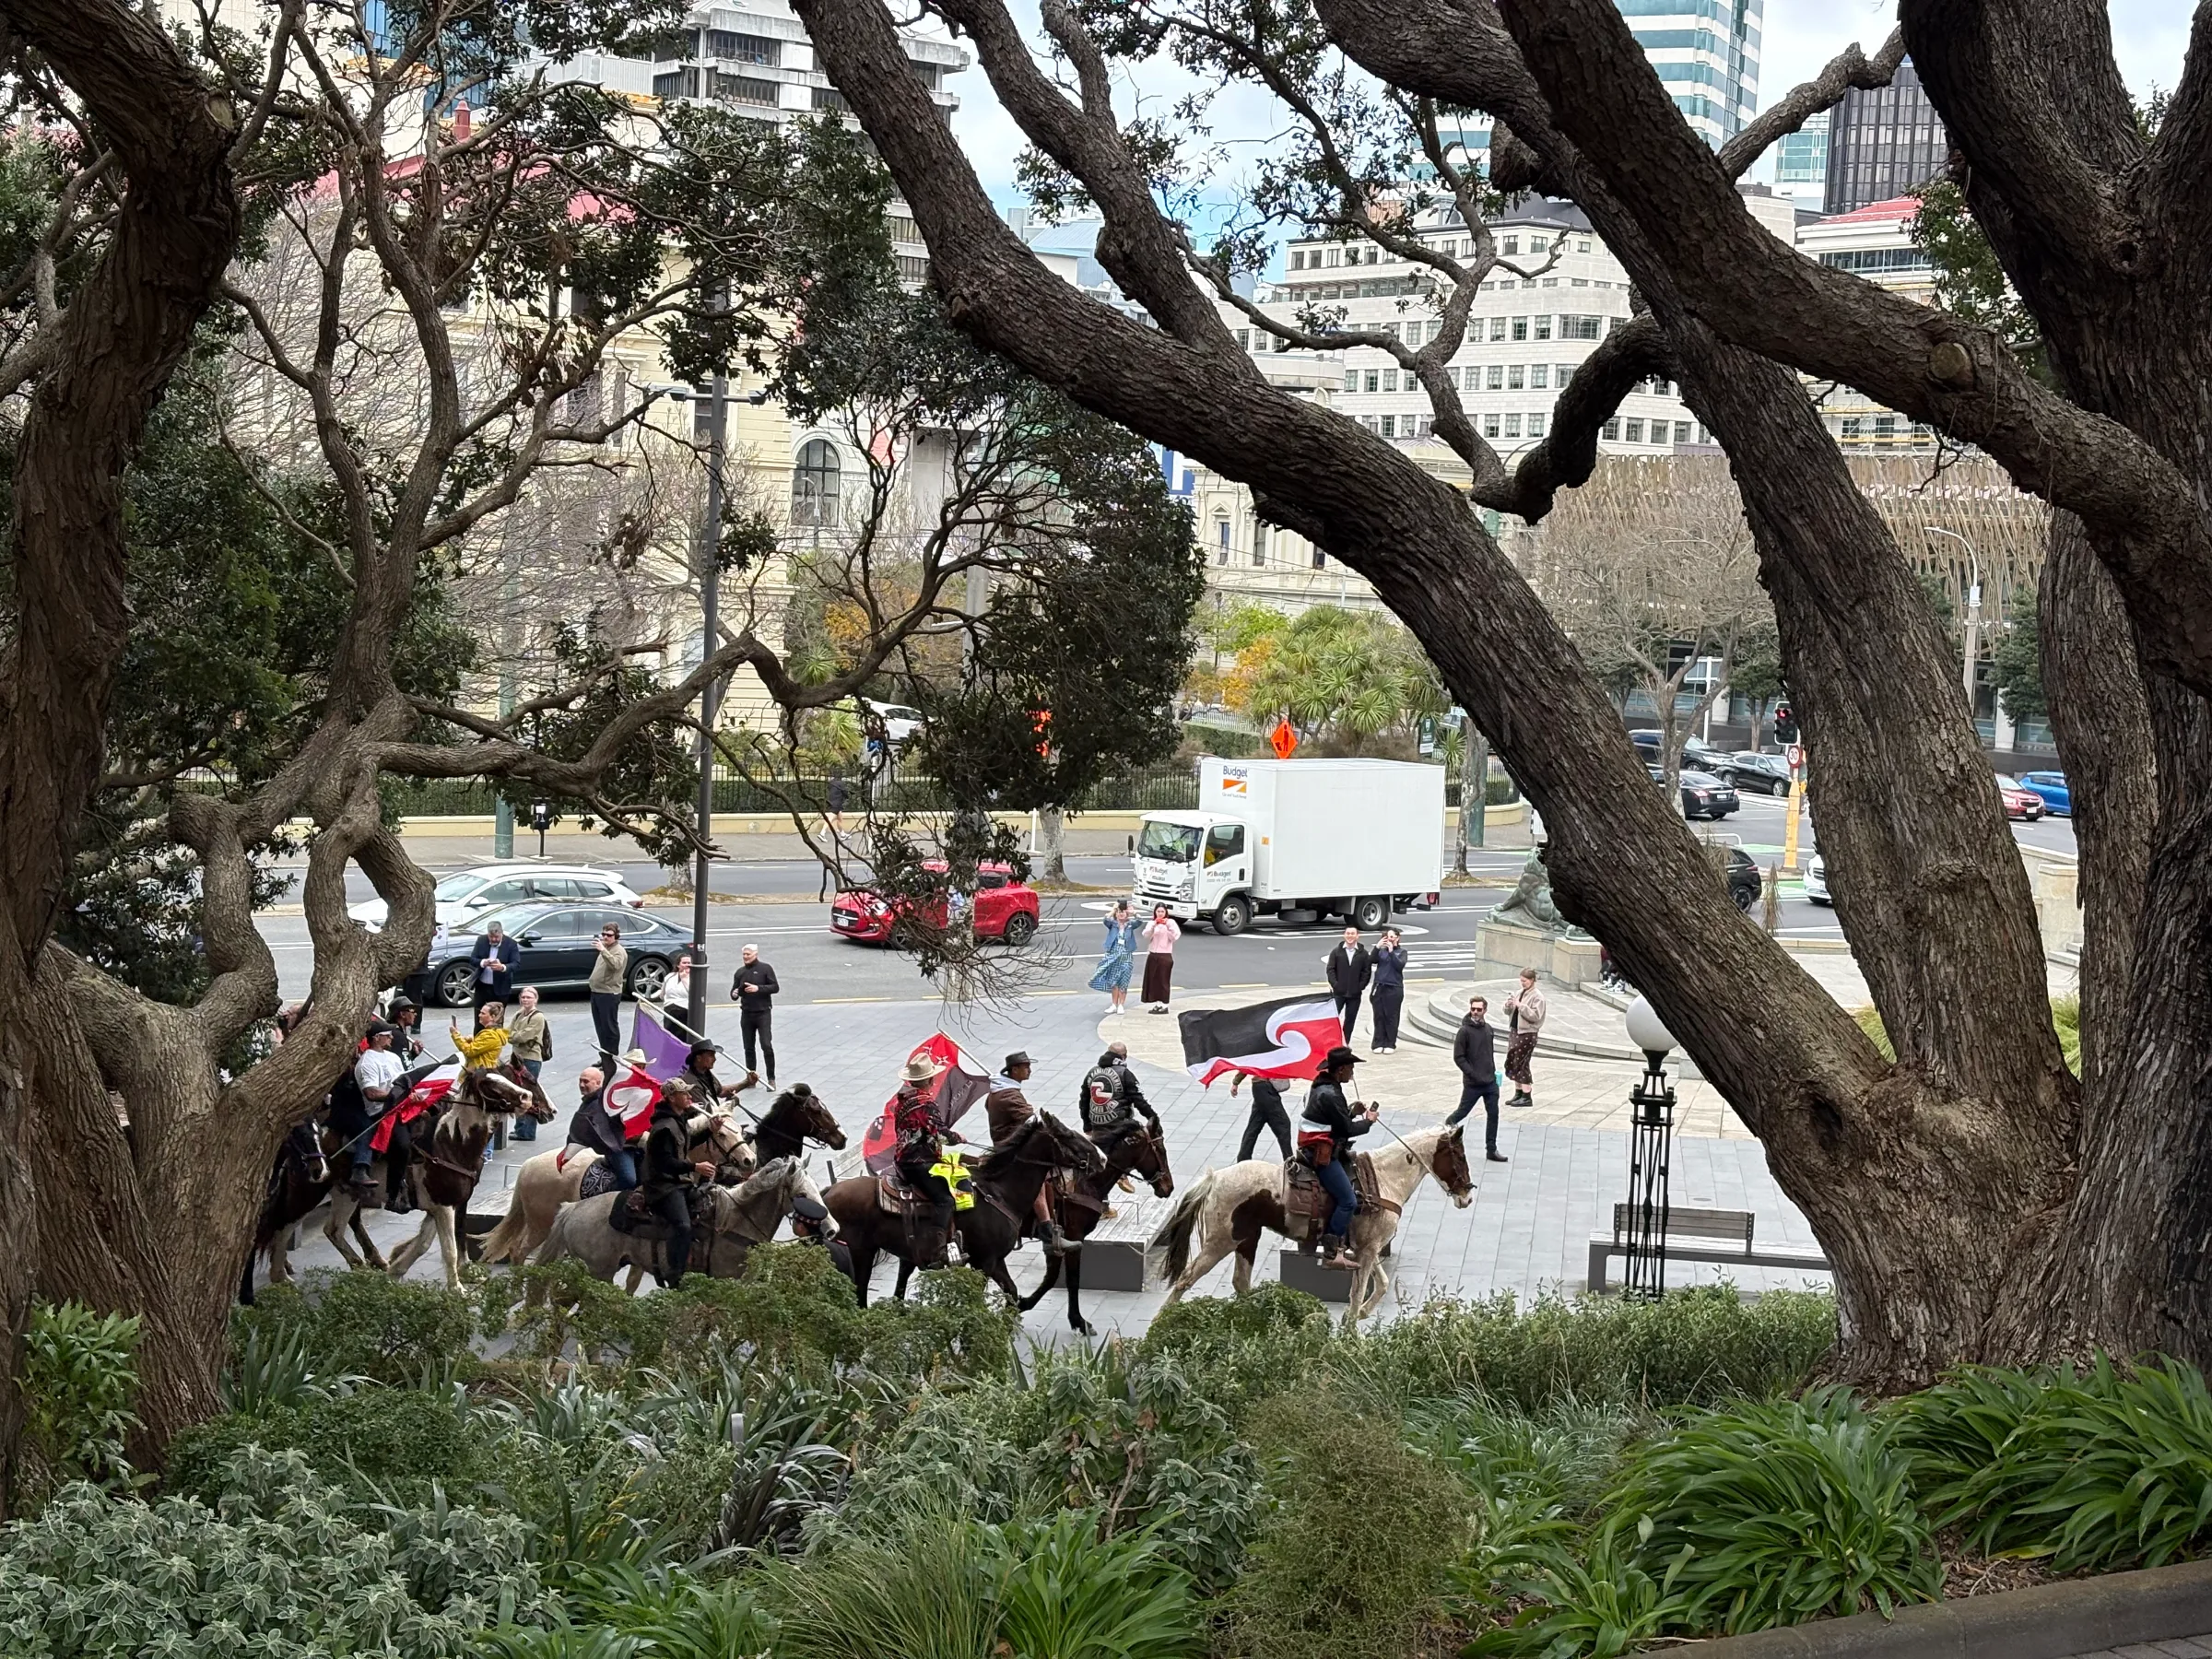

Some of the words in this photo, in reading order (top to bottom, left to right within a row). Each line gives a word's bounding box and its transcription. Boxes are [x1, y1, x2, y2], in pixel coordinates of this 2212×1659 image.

[1790, 750, 1797, 760] 30
[1223, 765, 1248, 779] Budget
[1213, 870, 1231, 878] Budget
